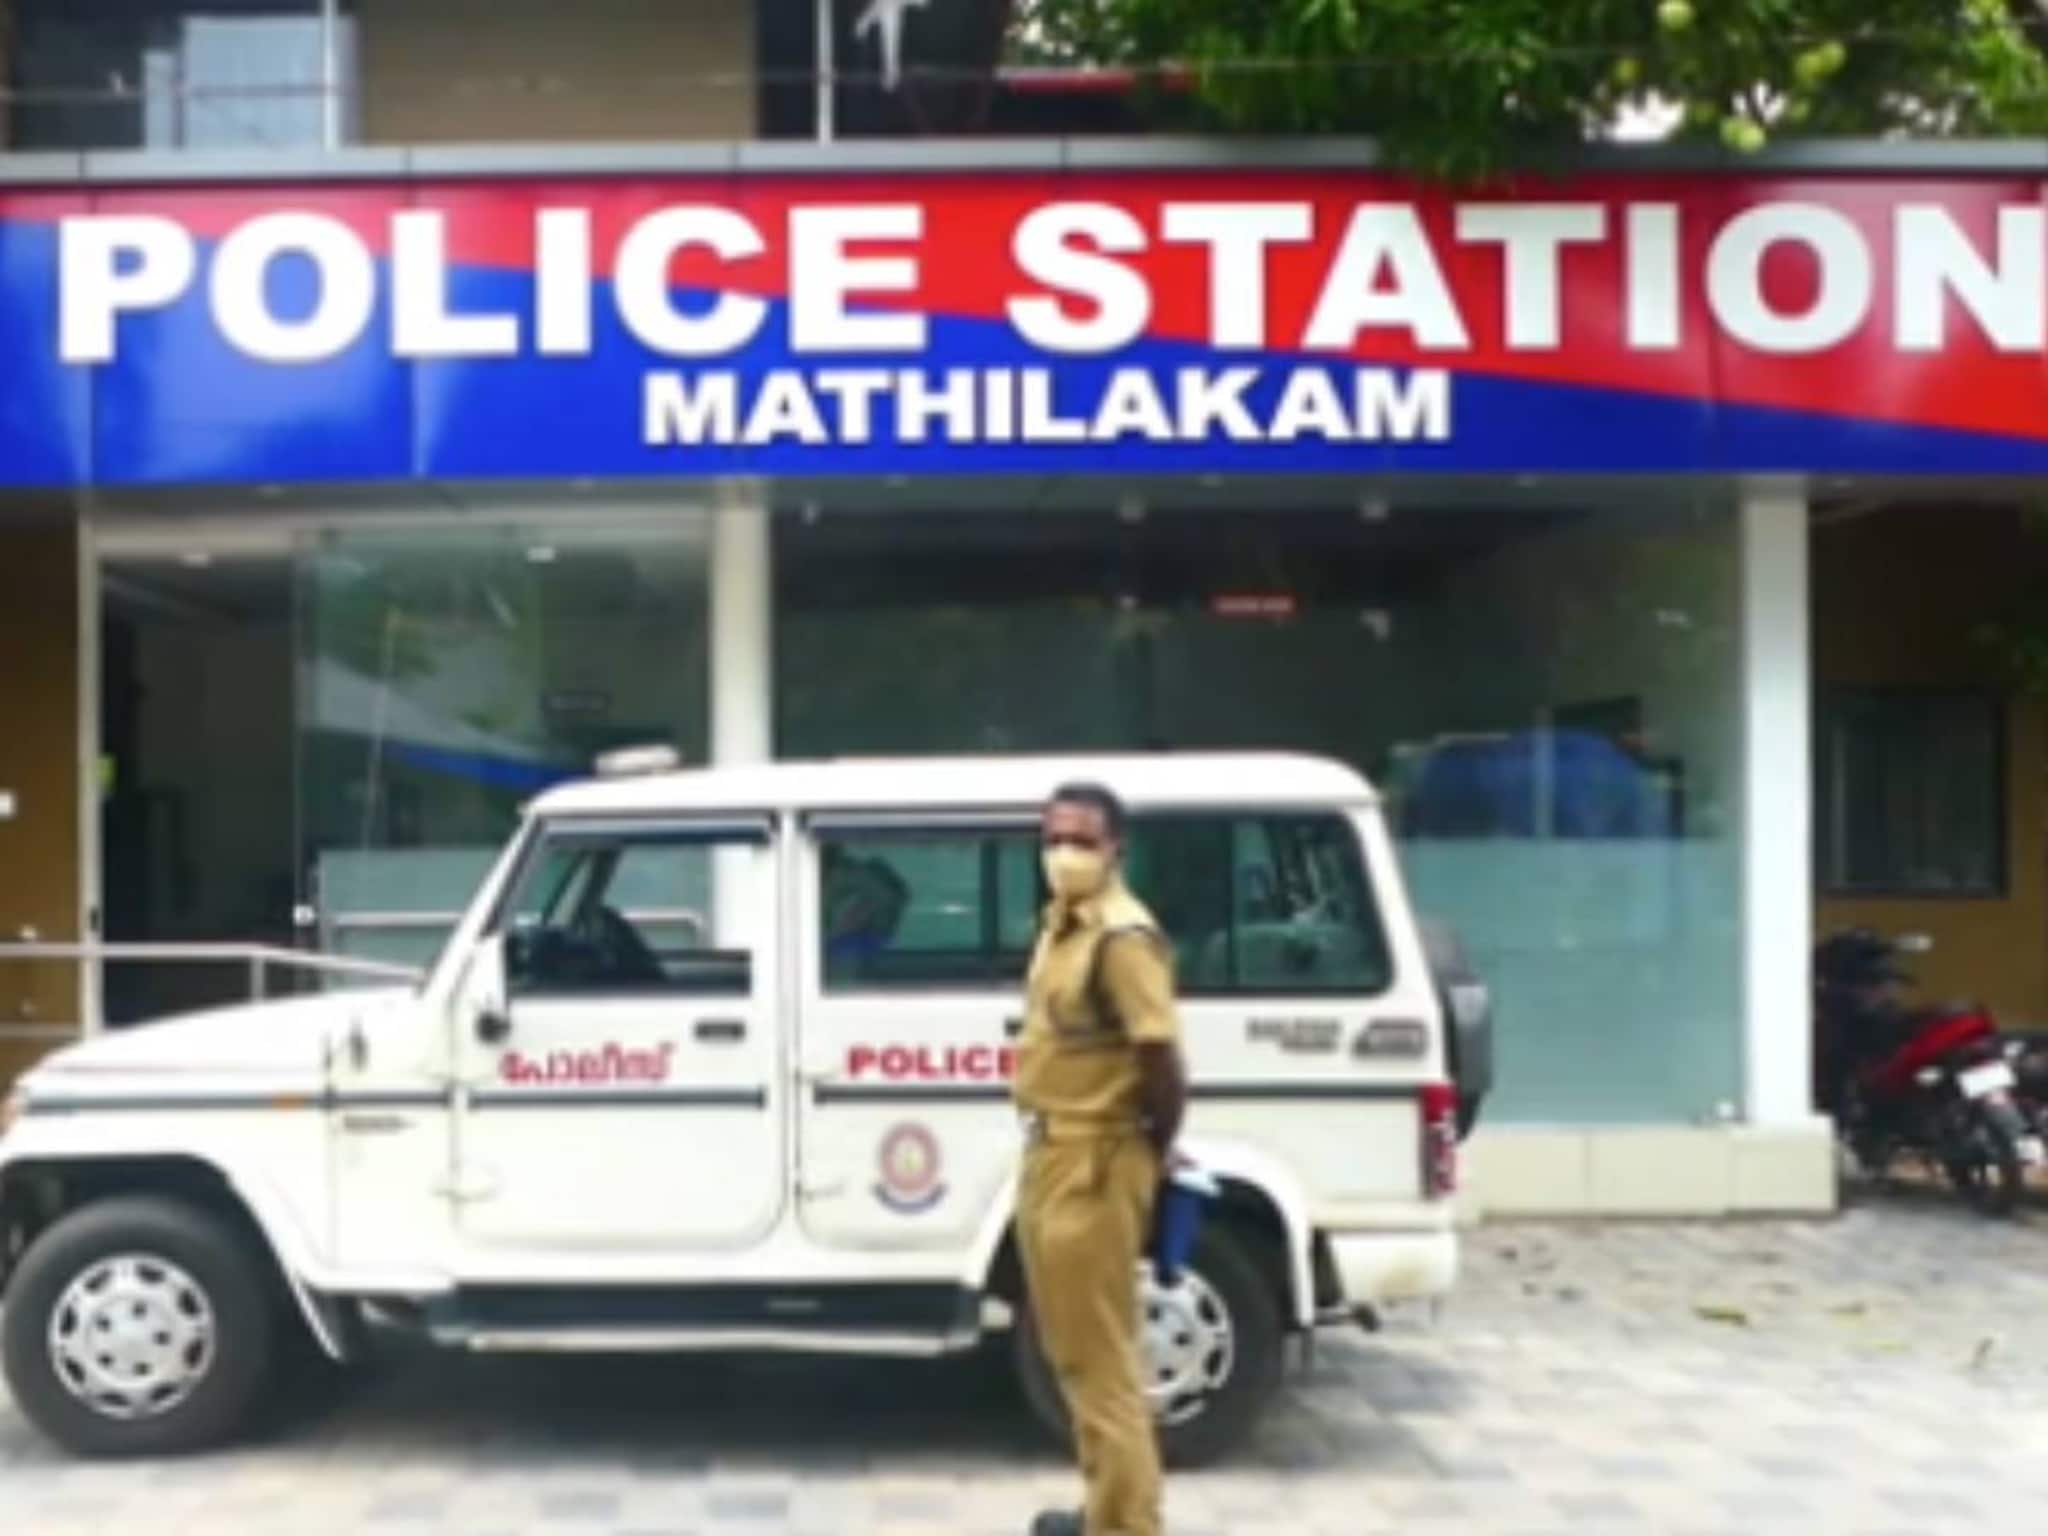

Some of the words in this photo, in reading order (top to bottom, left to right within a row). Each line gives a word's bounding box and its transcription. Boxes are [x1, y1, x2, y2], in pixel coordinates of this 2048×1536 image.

[57, 203, 928, 363] POLICE
[1005, 200, 2045, 355] STATION
[642, 366, 1452, 446] MATHILAKAM
